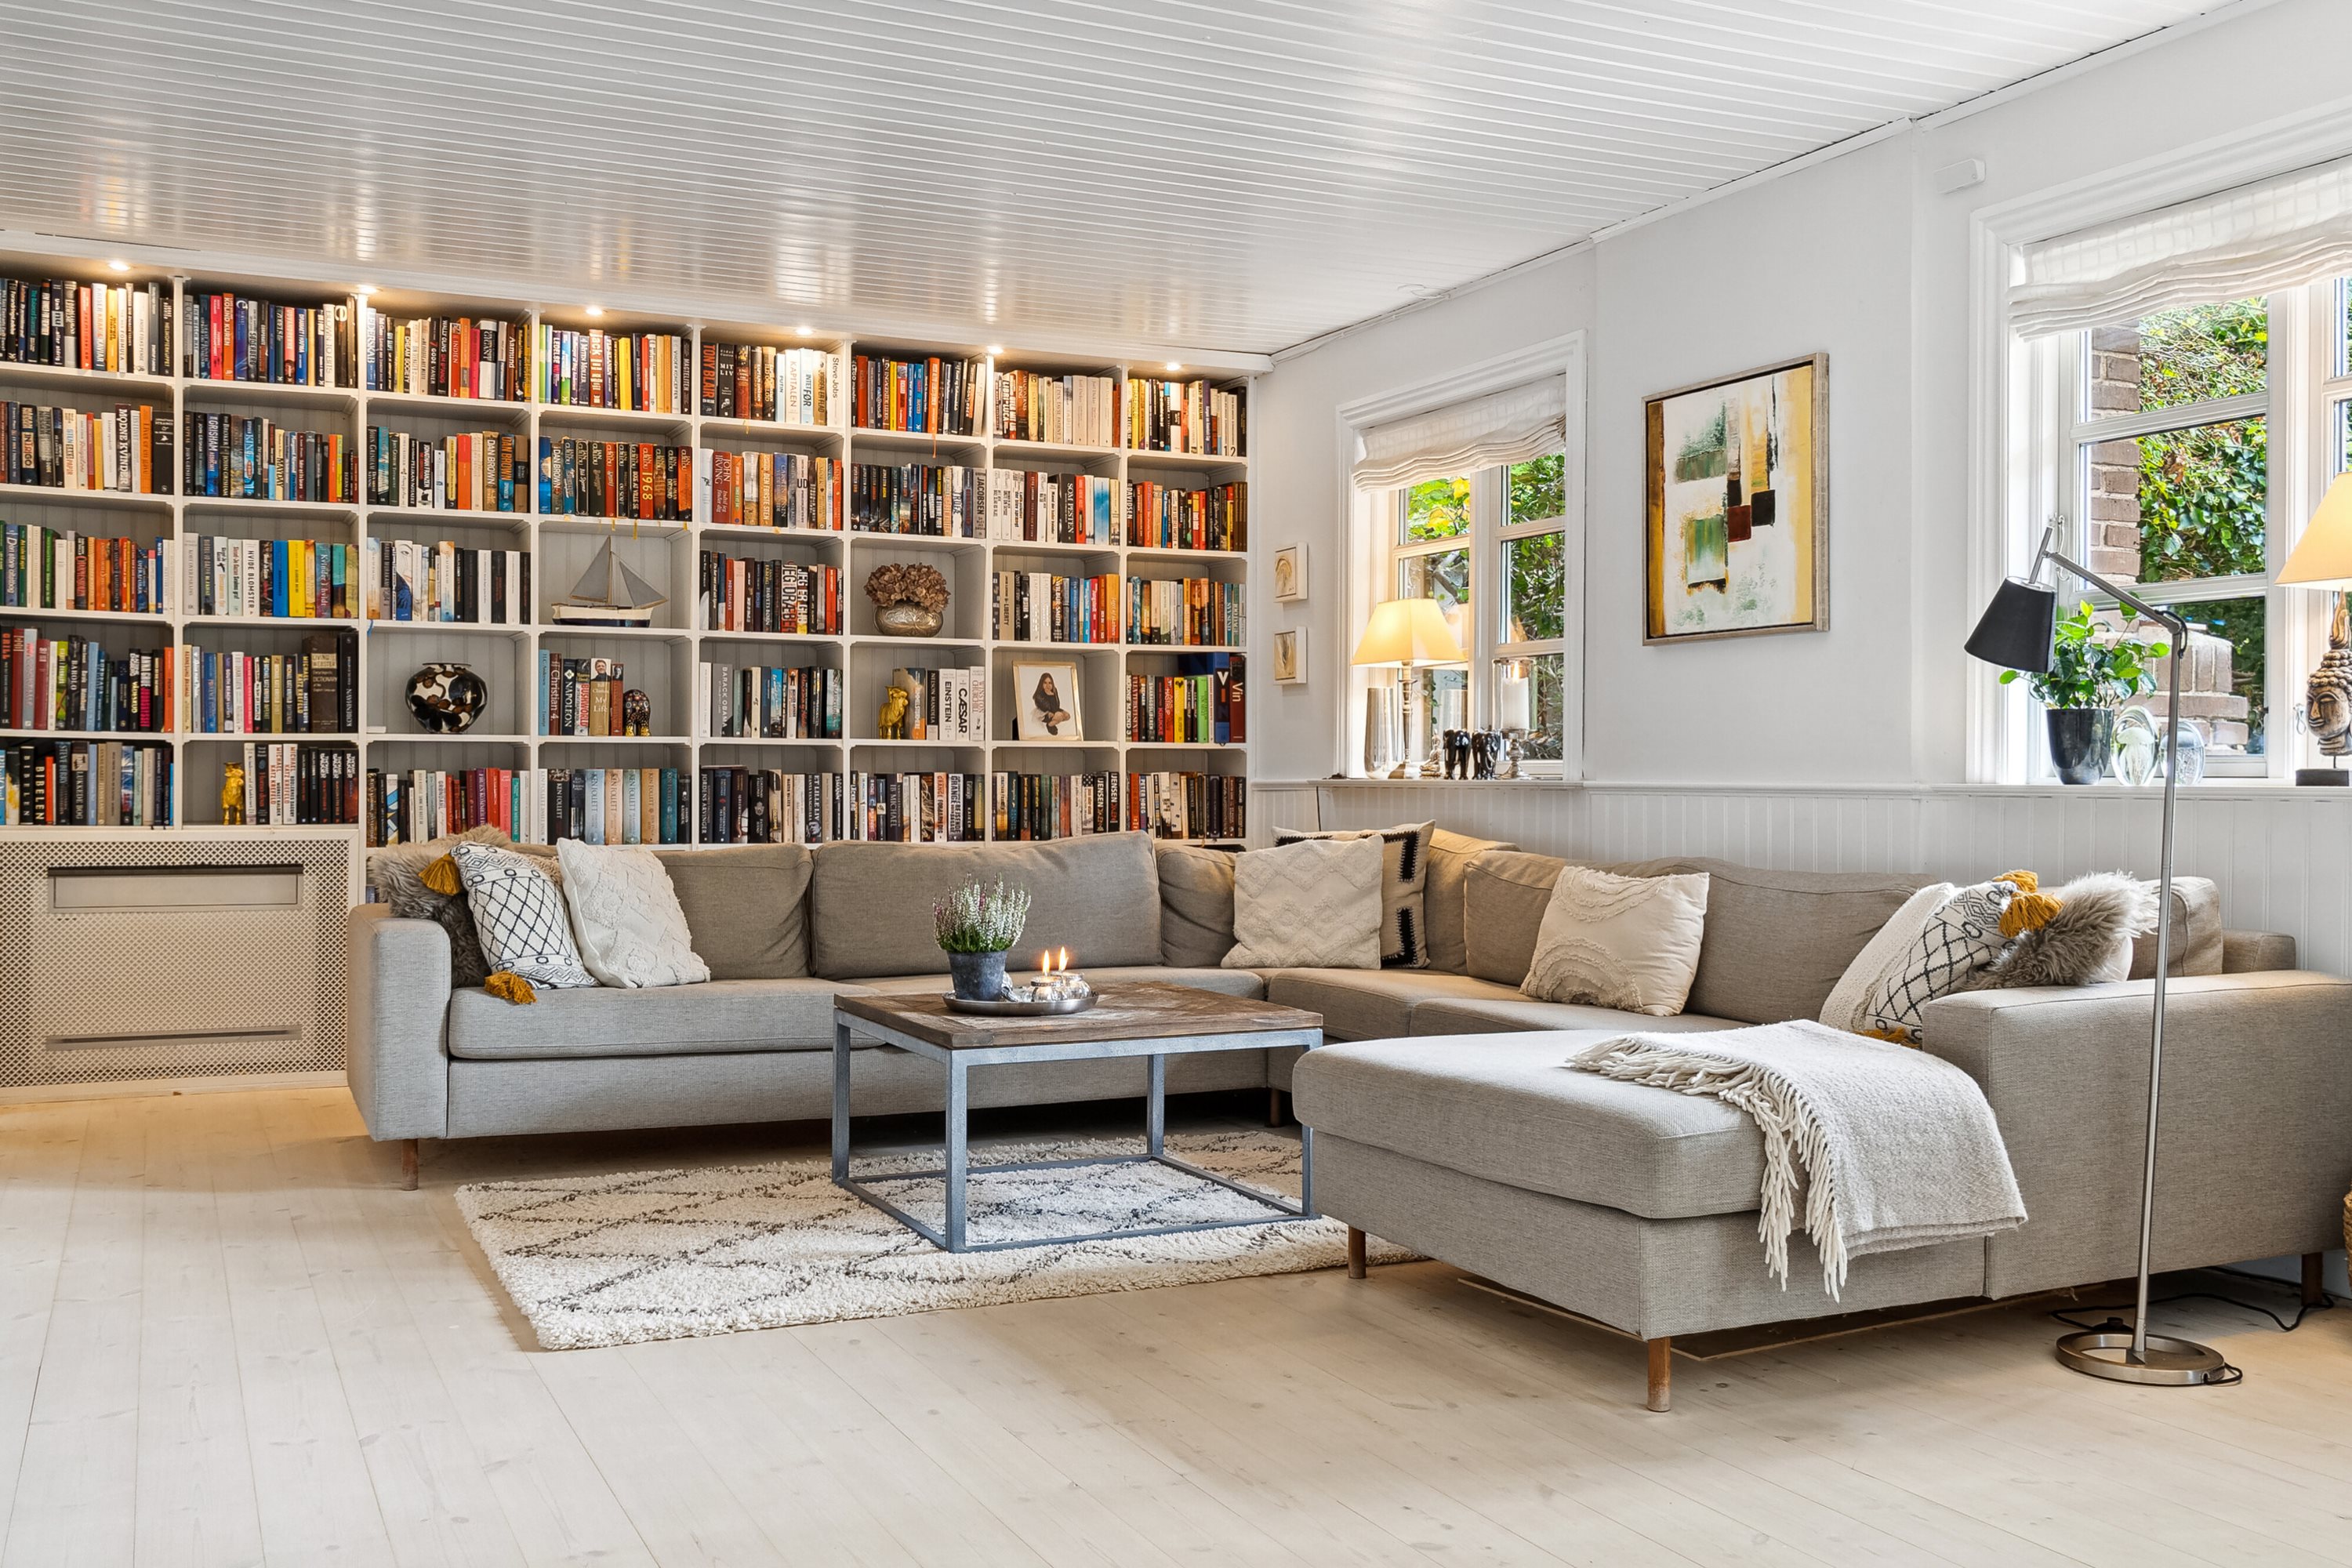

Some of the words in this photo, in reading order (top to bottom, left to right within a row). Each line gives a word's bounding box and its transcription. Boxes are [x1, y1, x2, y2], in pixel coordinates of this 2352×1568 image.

[703, 345, 715, 368] TONY
[702, 370, 715, 397] BLAIR
[209, 420, 217, 451] GRISHAM
[245, 434, 254, 456] KING
[502, 437, 511, 452] DAN
[119, 442, 128, 485] KVINDER
[502, 453, 511, 480] BROWN
[643, 471, 652, 500] 1968
[7, 537, 17, 555] Den
[782, 564, 796, 582] JEG
[798, 569, 808, 586] JEG
[797, 590, 808, 602] ER
[141, 656, 151, 671] ANNA
[550, 670, 559, 710] Christian
[1232, 682, 1243, 702] Vin
[564, 681, 573, 728] NAPOLEON
[580, 684, 589, 727] BUSHWORLD
[959, 688, 967, 733] CÆSAR
[35, 767, 45, 819] BIBELEN
[815, 775, 819, 786] ET
